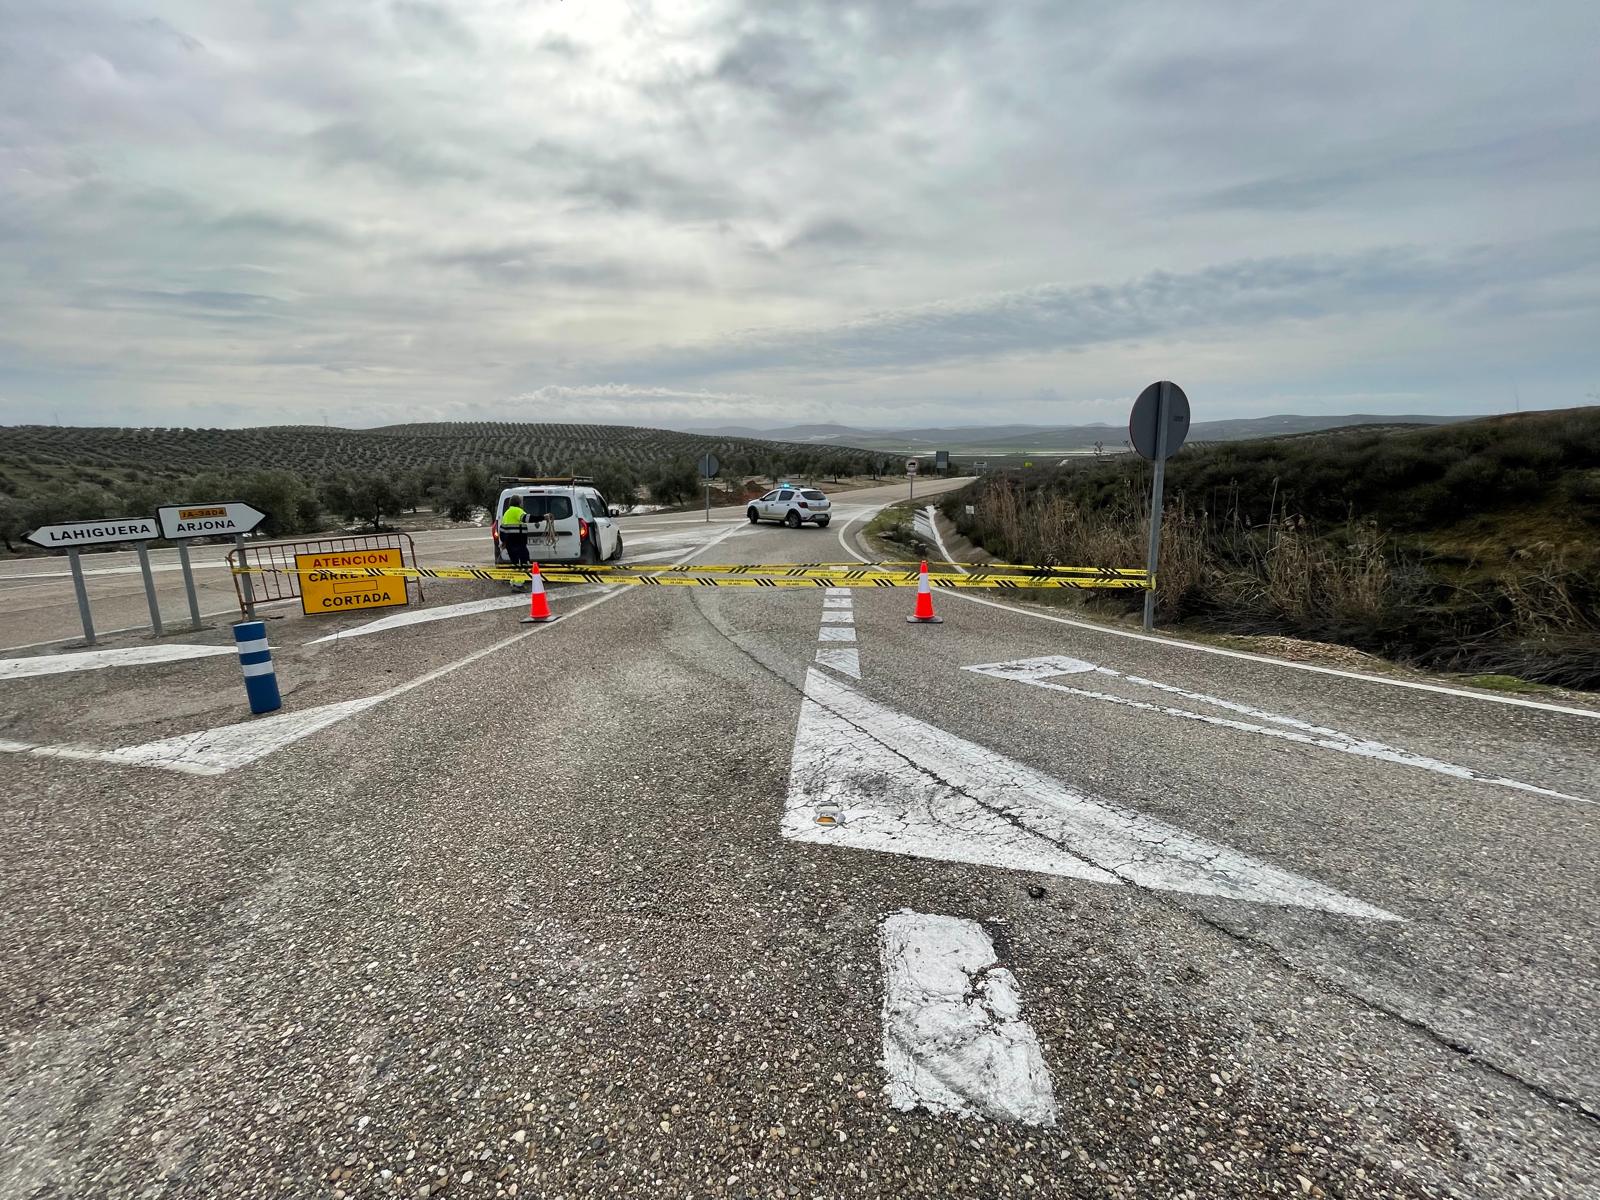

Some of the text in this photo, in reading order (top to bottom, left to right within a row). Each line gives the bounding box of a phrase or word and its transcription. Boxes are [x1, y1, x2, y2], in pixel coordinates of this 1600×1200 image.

[50, 525, 151, 541] LAHIGUERA
[177, 520, 236, 532] ARJONA
[322, 592, 391, 608] CORTADA
